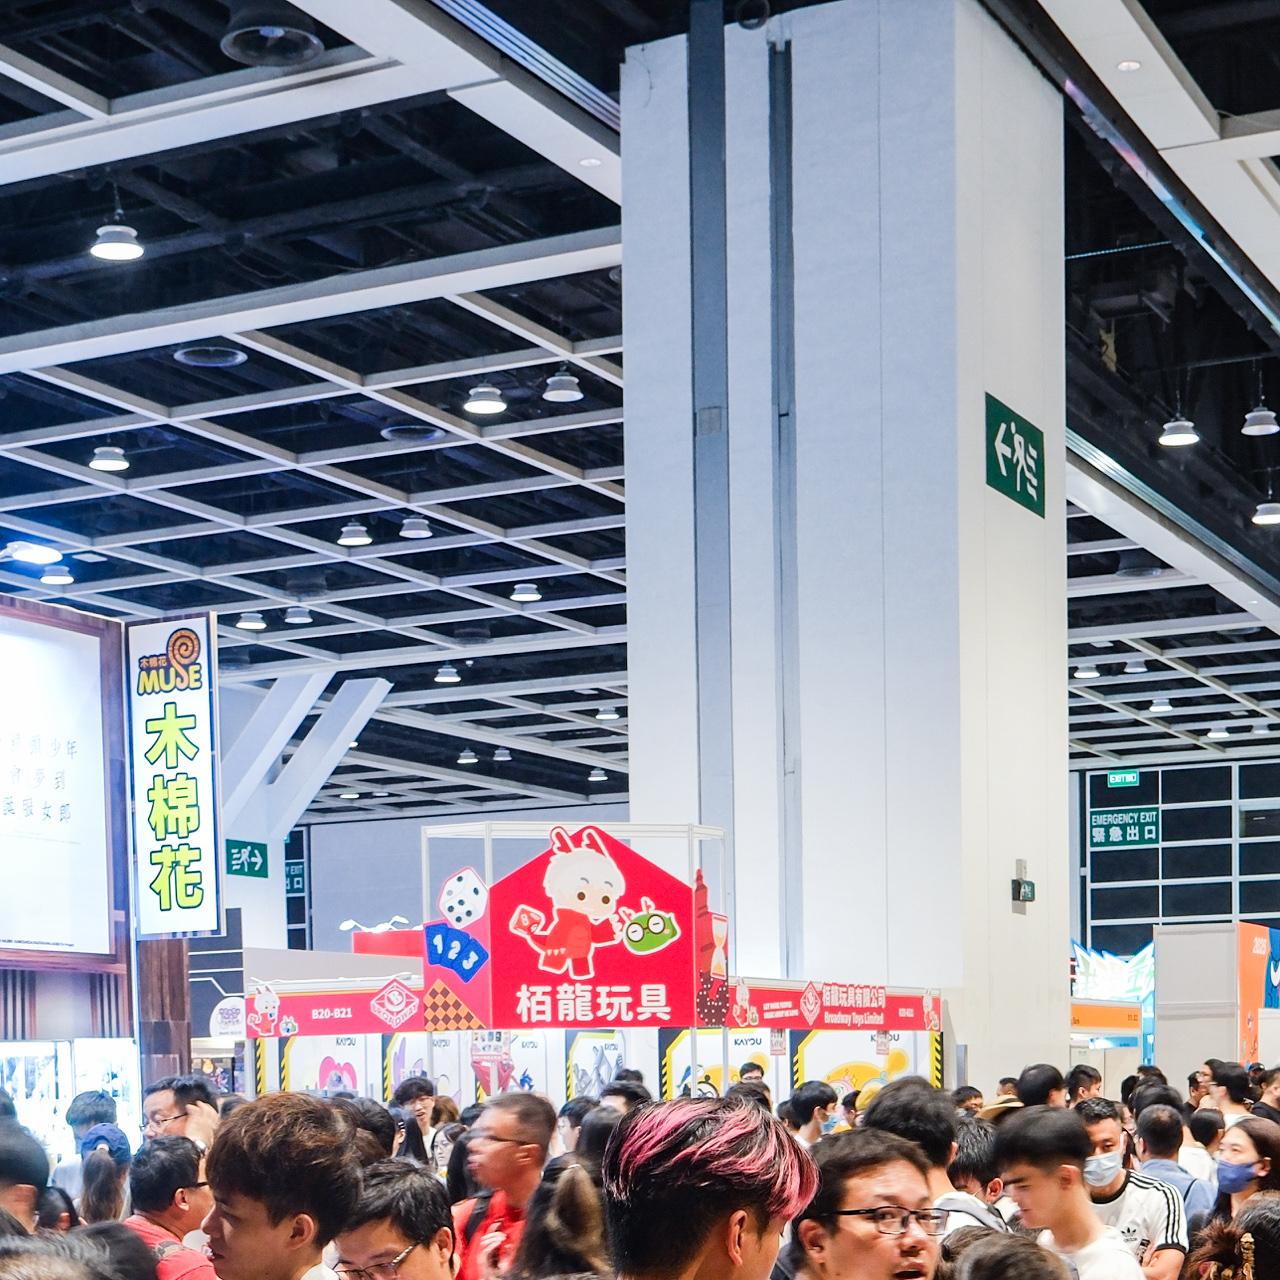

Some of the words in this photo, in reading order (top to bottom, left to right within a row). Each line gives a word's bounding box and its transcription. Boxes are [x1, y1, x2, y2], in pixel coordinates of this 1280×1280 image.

[137, 663, 202, 695] MUSE
[145, 702, 204, 911] 木棉花
[1091, 812, 1139, 826] EMERGENCY
[1140, 811, 1158, 823] EXIT
[1092, 825, 1157, 843] 緊急出口
[291, 865, 303, 875] EXIT
[433, 933, 443, 954] 1
[447, 940, 461, 959] 2
[462, 951, 479, 970] 3
[516, 983, 672, 1024] 栢龍玩具
[312, 1008, 352, 1020] B20-B21
[824, 1011, 851, 1026] Broadway
[852, 1012, 864, 1027] Toys
[864, 1012, 884, 1025] Limited
